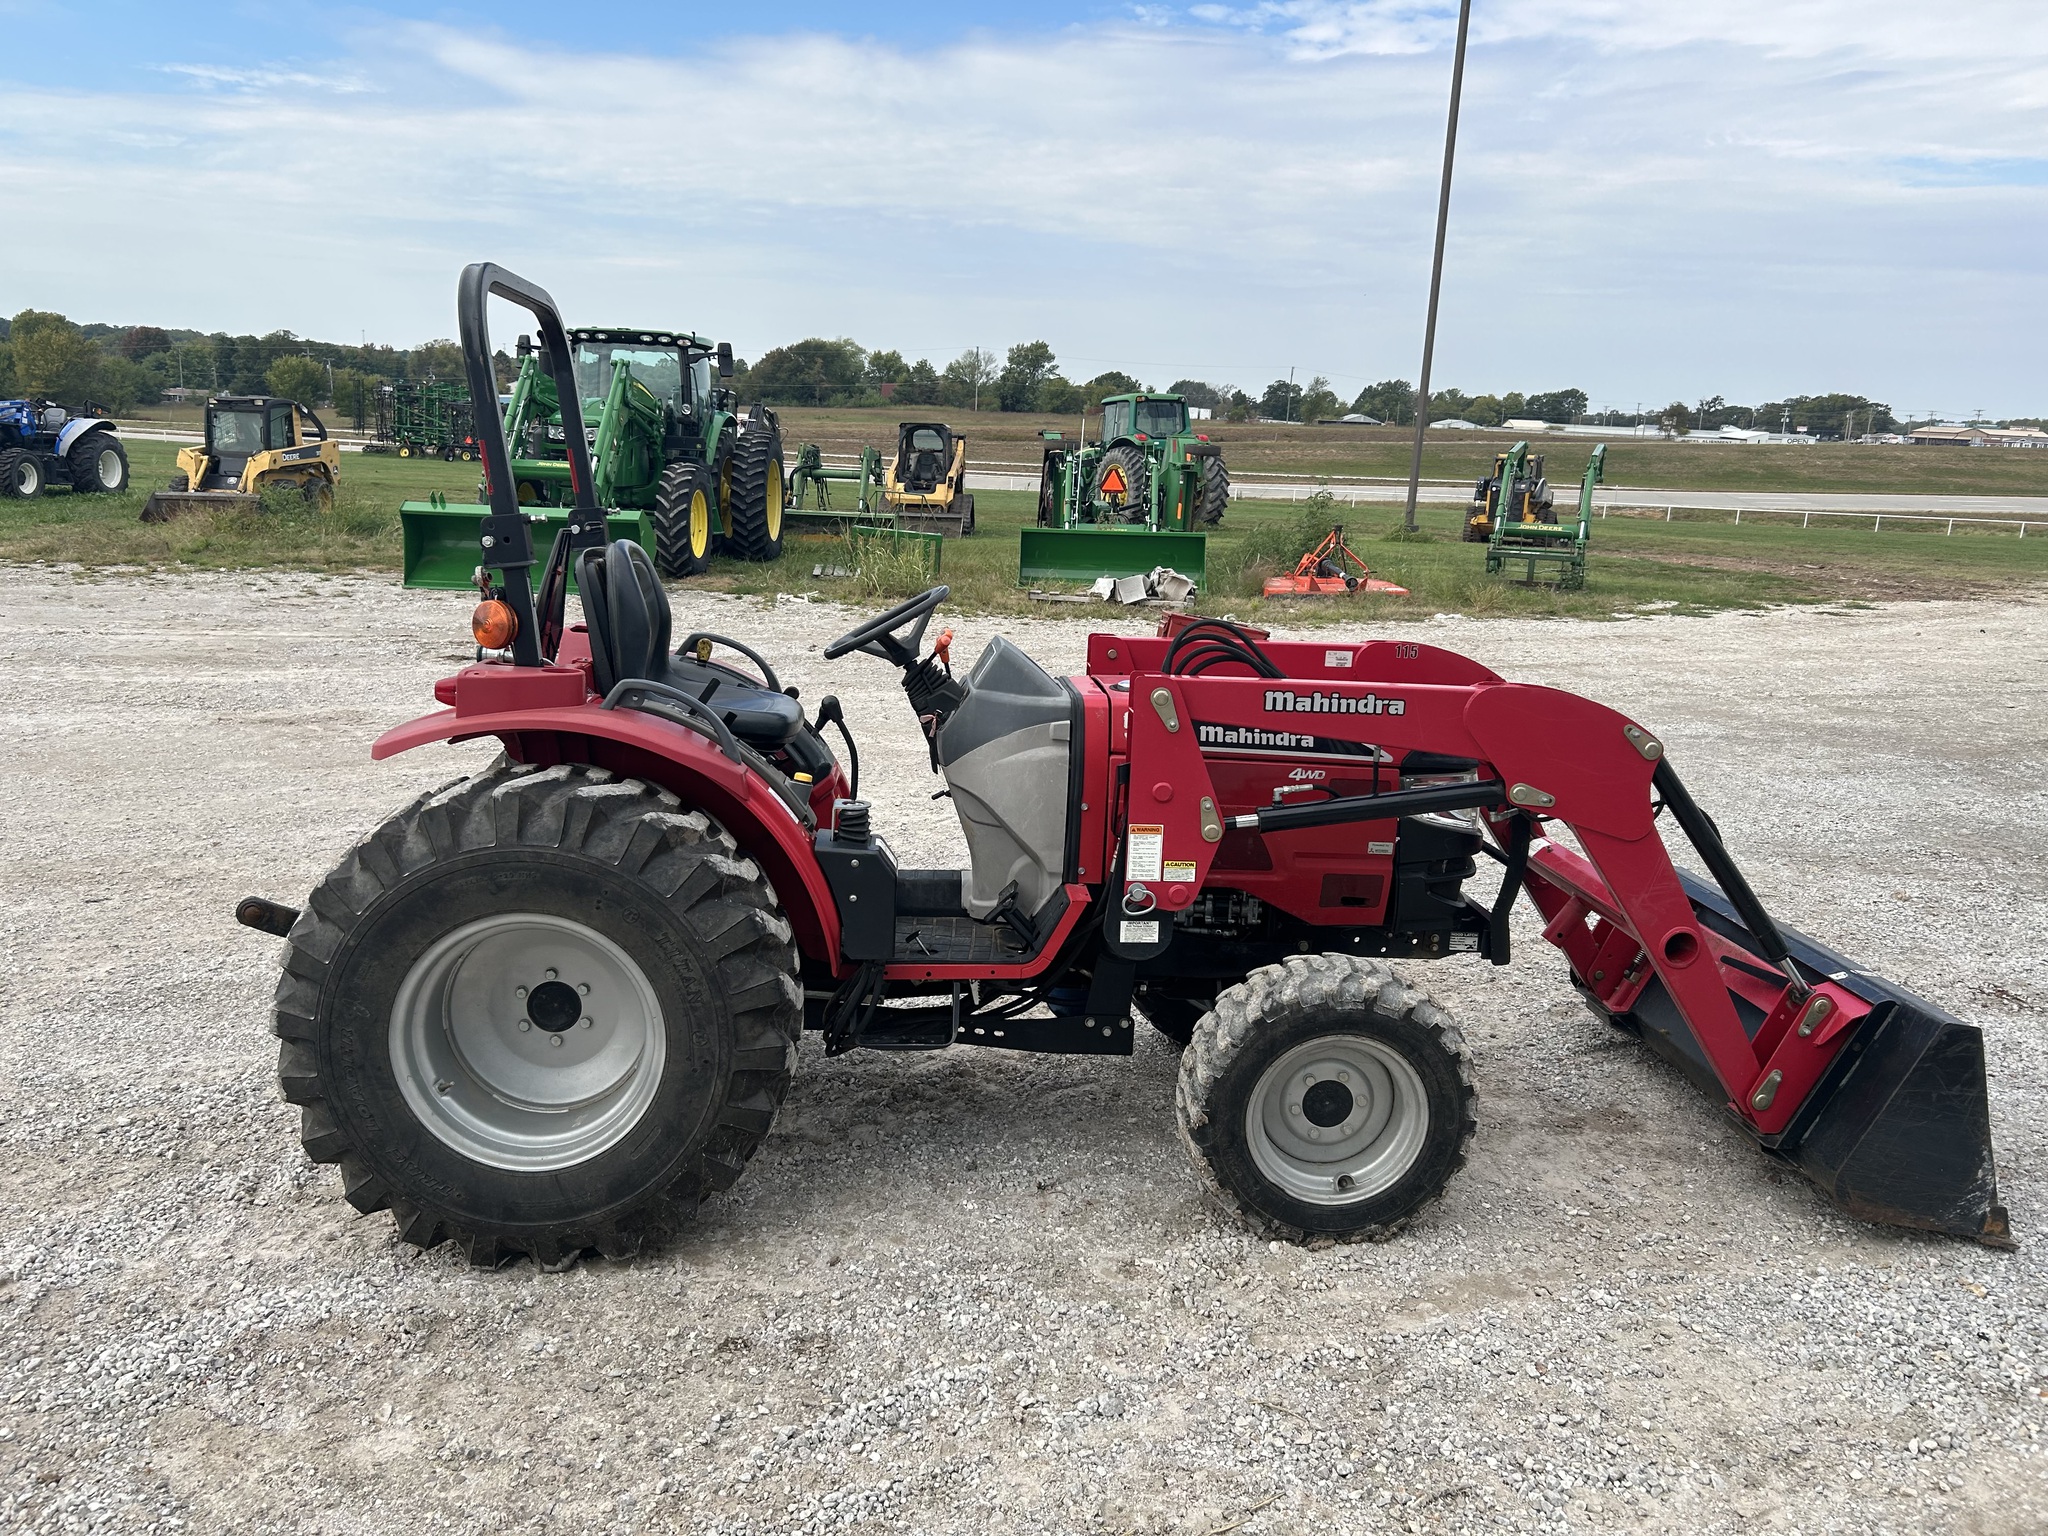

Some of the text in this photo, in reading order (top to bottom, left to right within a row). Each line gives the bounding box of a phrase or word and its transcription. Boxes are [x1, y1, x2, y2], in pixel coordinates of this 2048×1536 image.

[282, 453, 300, 461] DEERE
[1395, 644, 1418, 659] 115
[1264, 690, 1405, 715] Mahindra
[1200, 725, 1314, 748] Mahindra
[1288, 767, 1326, 780] 4WD
[655, 932, 704, 1004] TITAN
[340, 1027, 381, 1132] LOADER
[386, 1147, 453, 1197] TRAC
